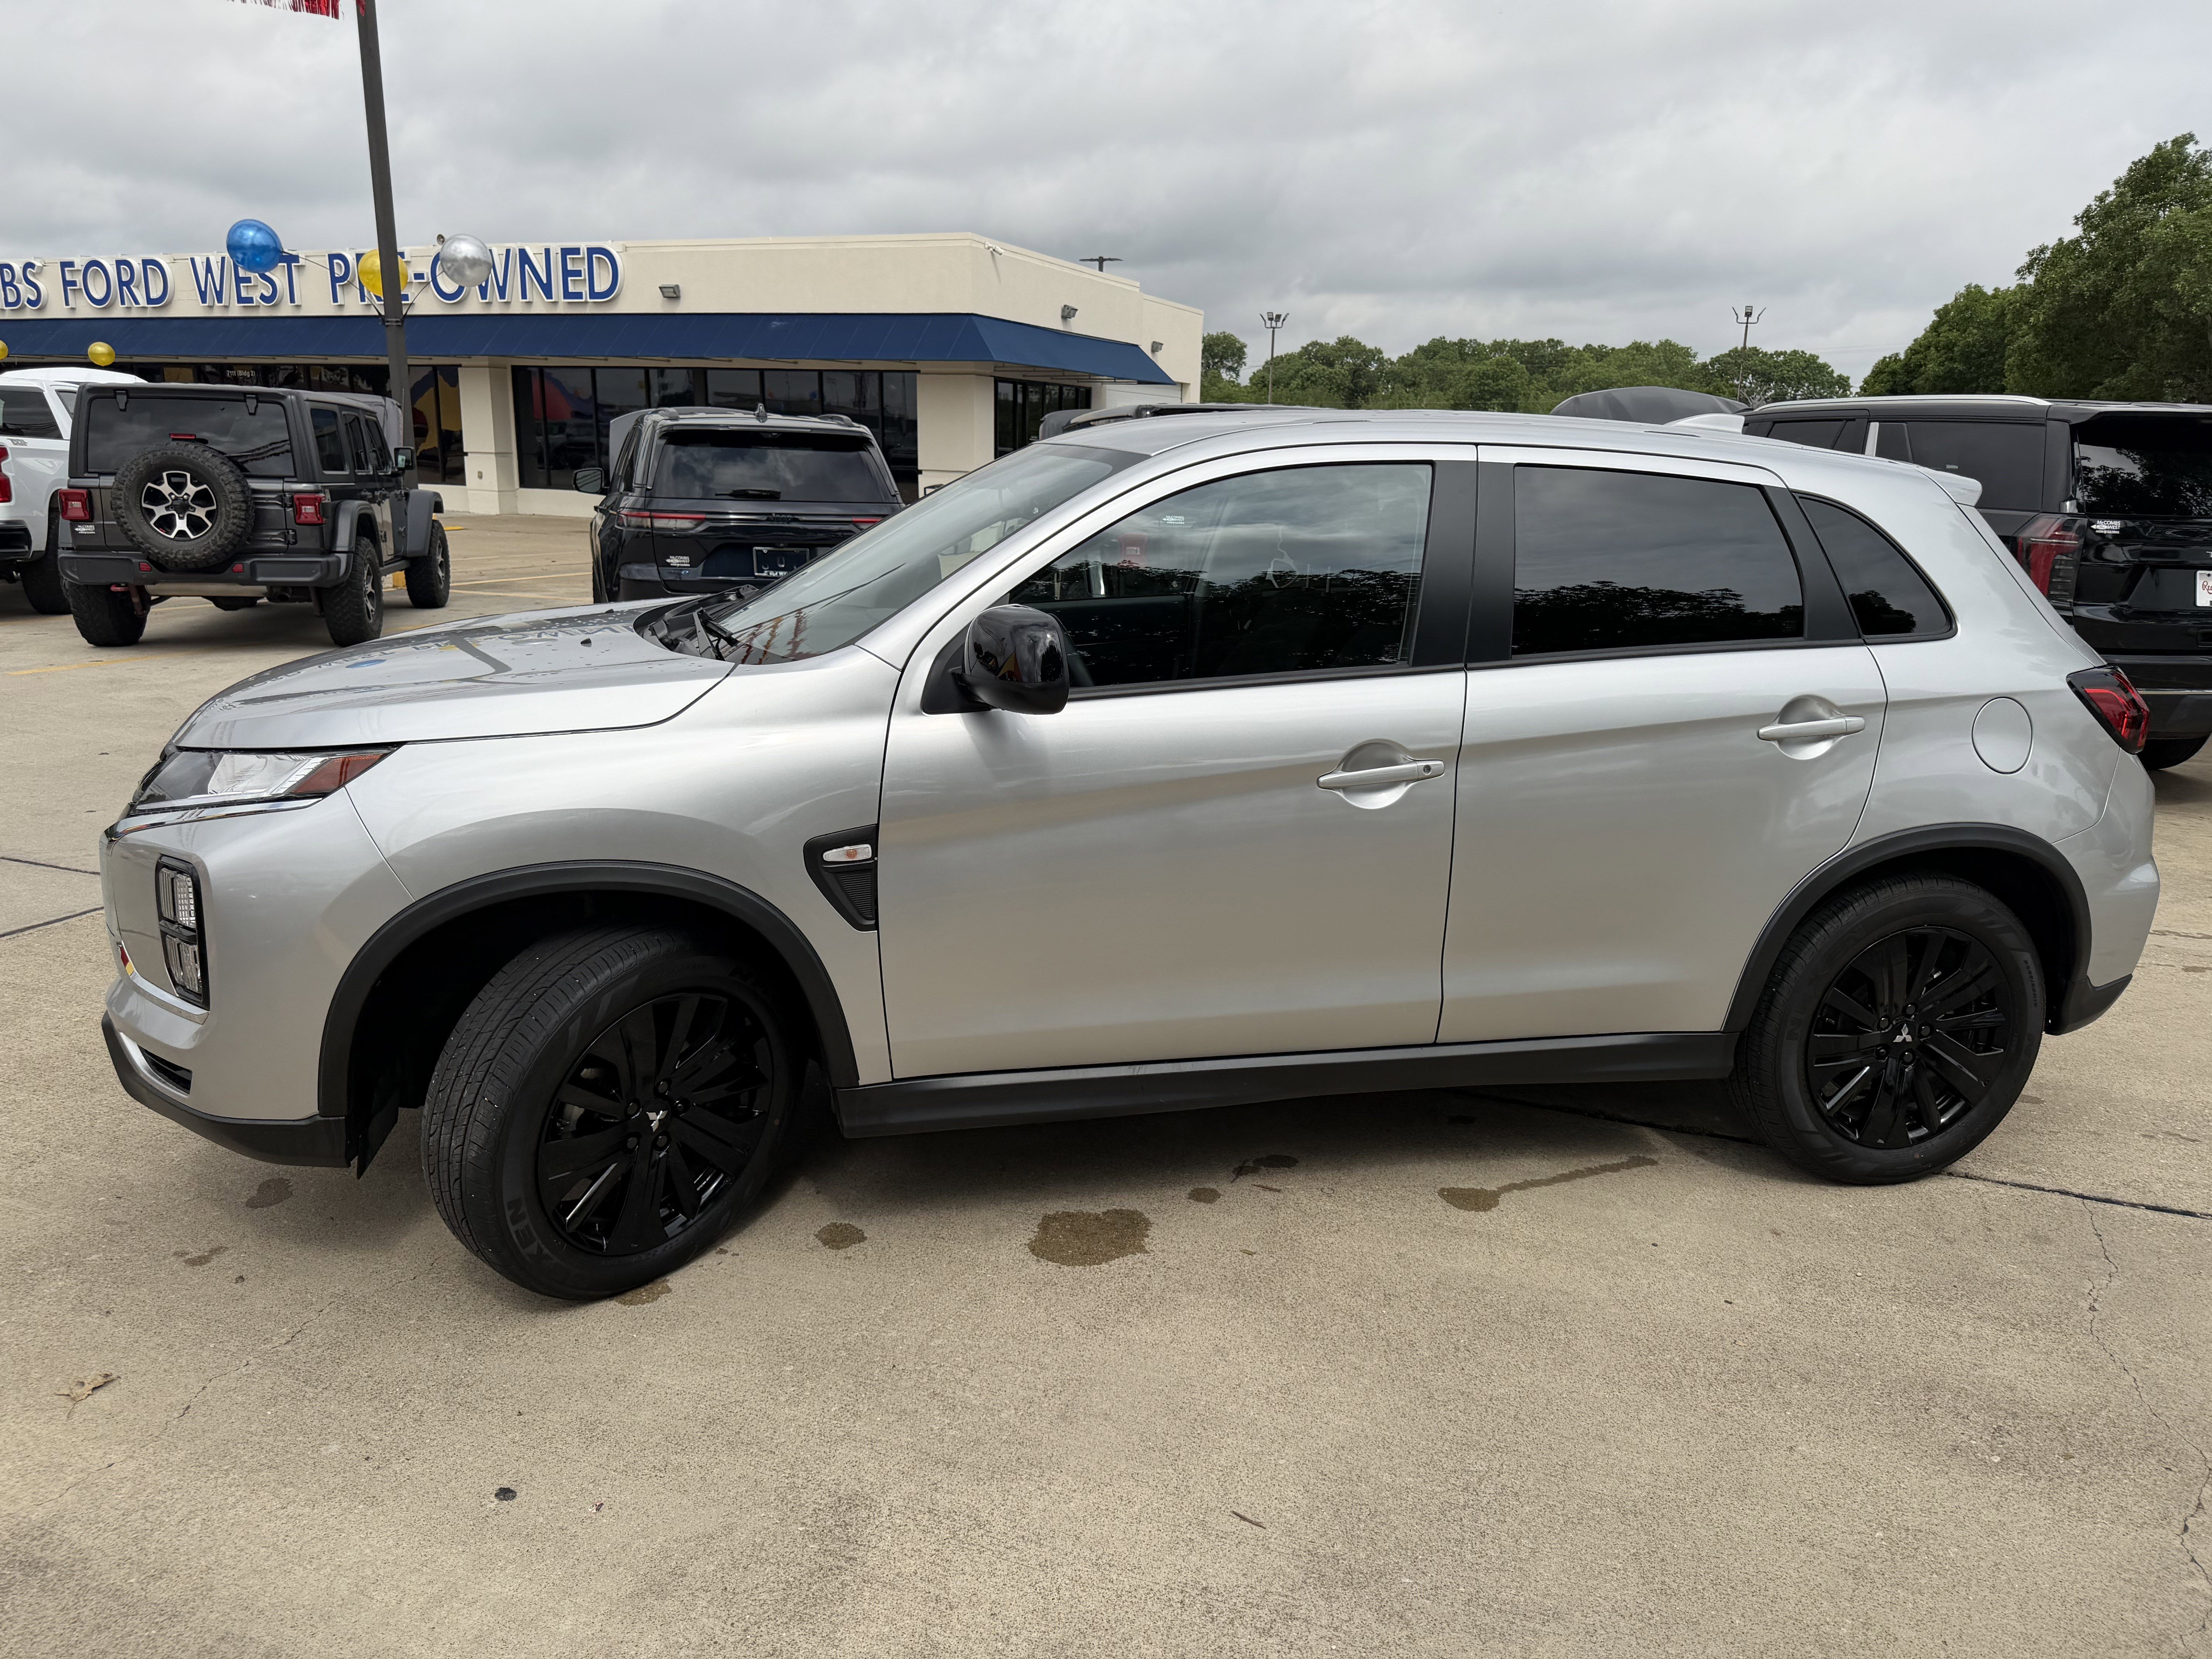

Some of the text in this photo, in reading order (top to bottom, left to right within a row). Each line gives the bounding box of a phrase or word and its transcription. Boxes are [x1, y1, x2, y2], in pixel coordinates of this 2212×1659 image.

[59, 257, 172, 308] FORD
[189, 254, 302, 306] WEST
[327, 246, 622, 305] P-OWNED
